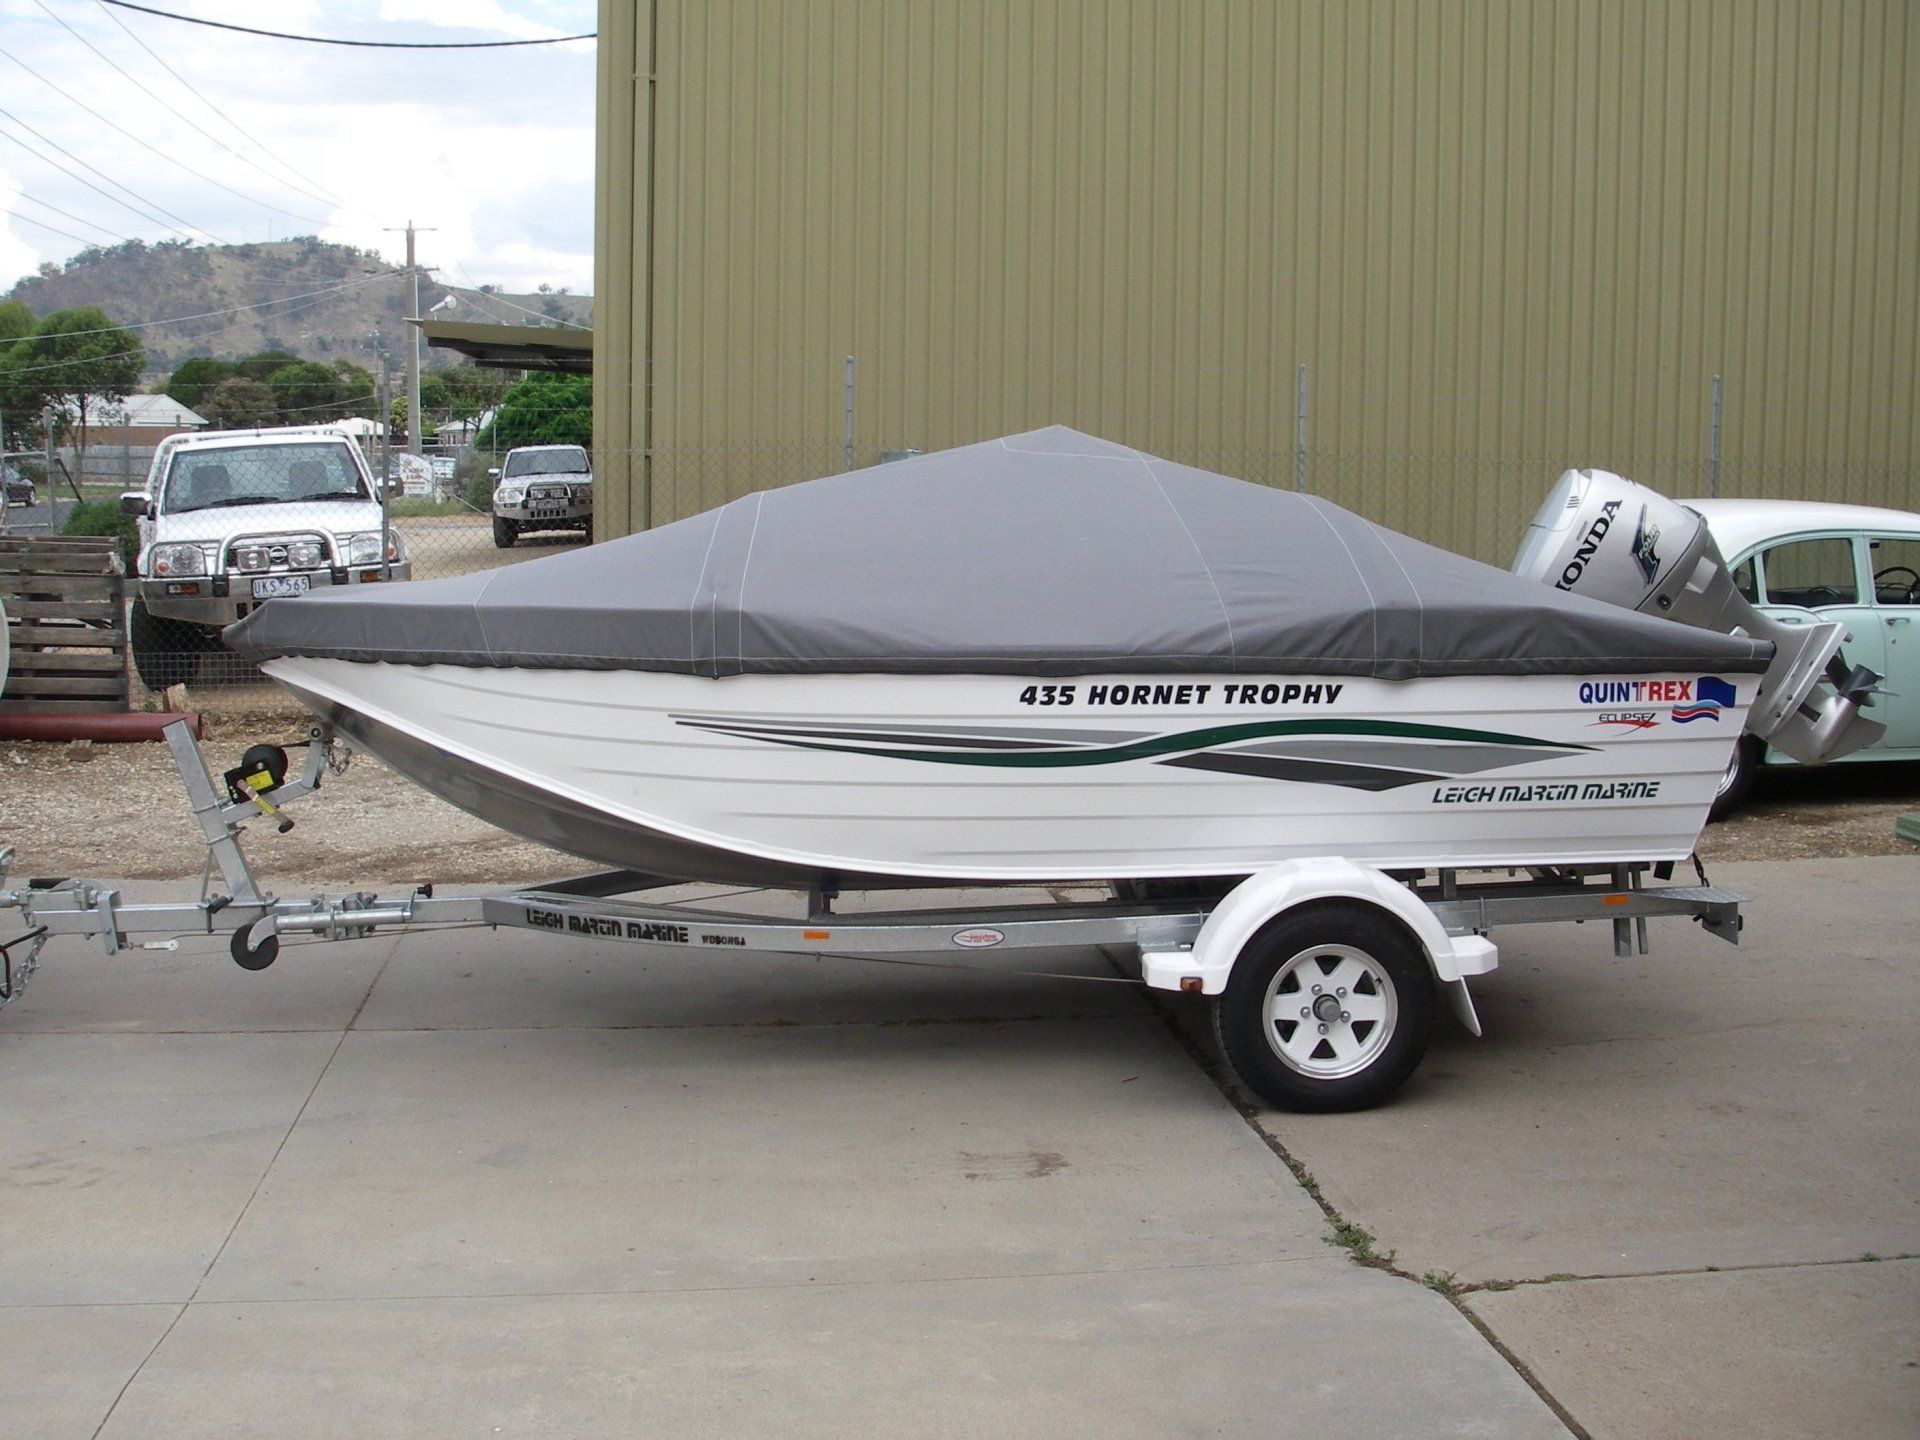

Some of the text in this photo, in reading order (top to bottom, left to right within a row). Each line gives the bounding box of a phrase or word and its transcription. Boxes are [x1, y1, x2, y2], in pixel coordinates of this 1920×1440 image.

[254, 578, 308, 594] UKS 565
[1020, 684, 1344, 706] 435 HORNET TROPHY
[1579, 681, 1692, 704] QUINTREX
[1432, 781, 1661, 804] LEIGH MARTIN MARINE
[526, 908, 563, 929] LEIGH
[568, 915, 622, 936] MARTIN
[627, 922, 689, 943] MARINE
